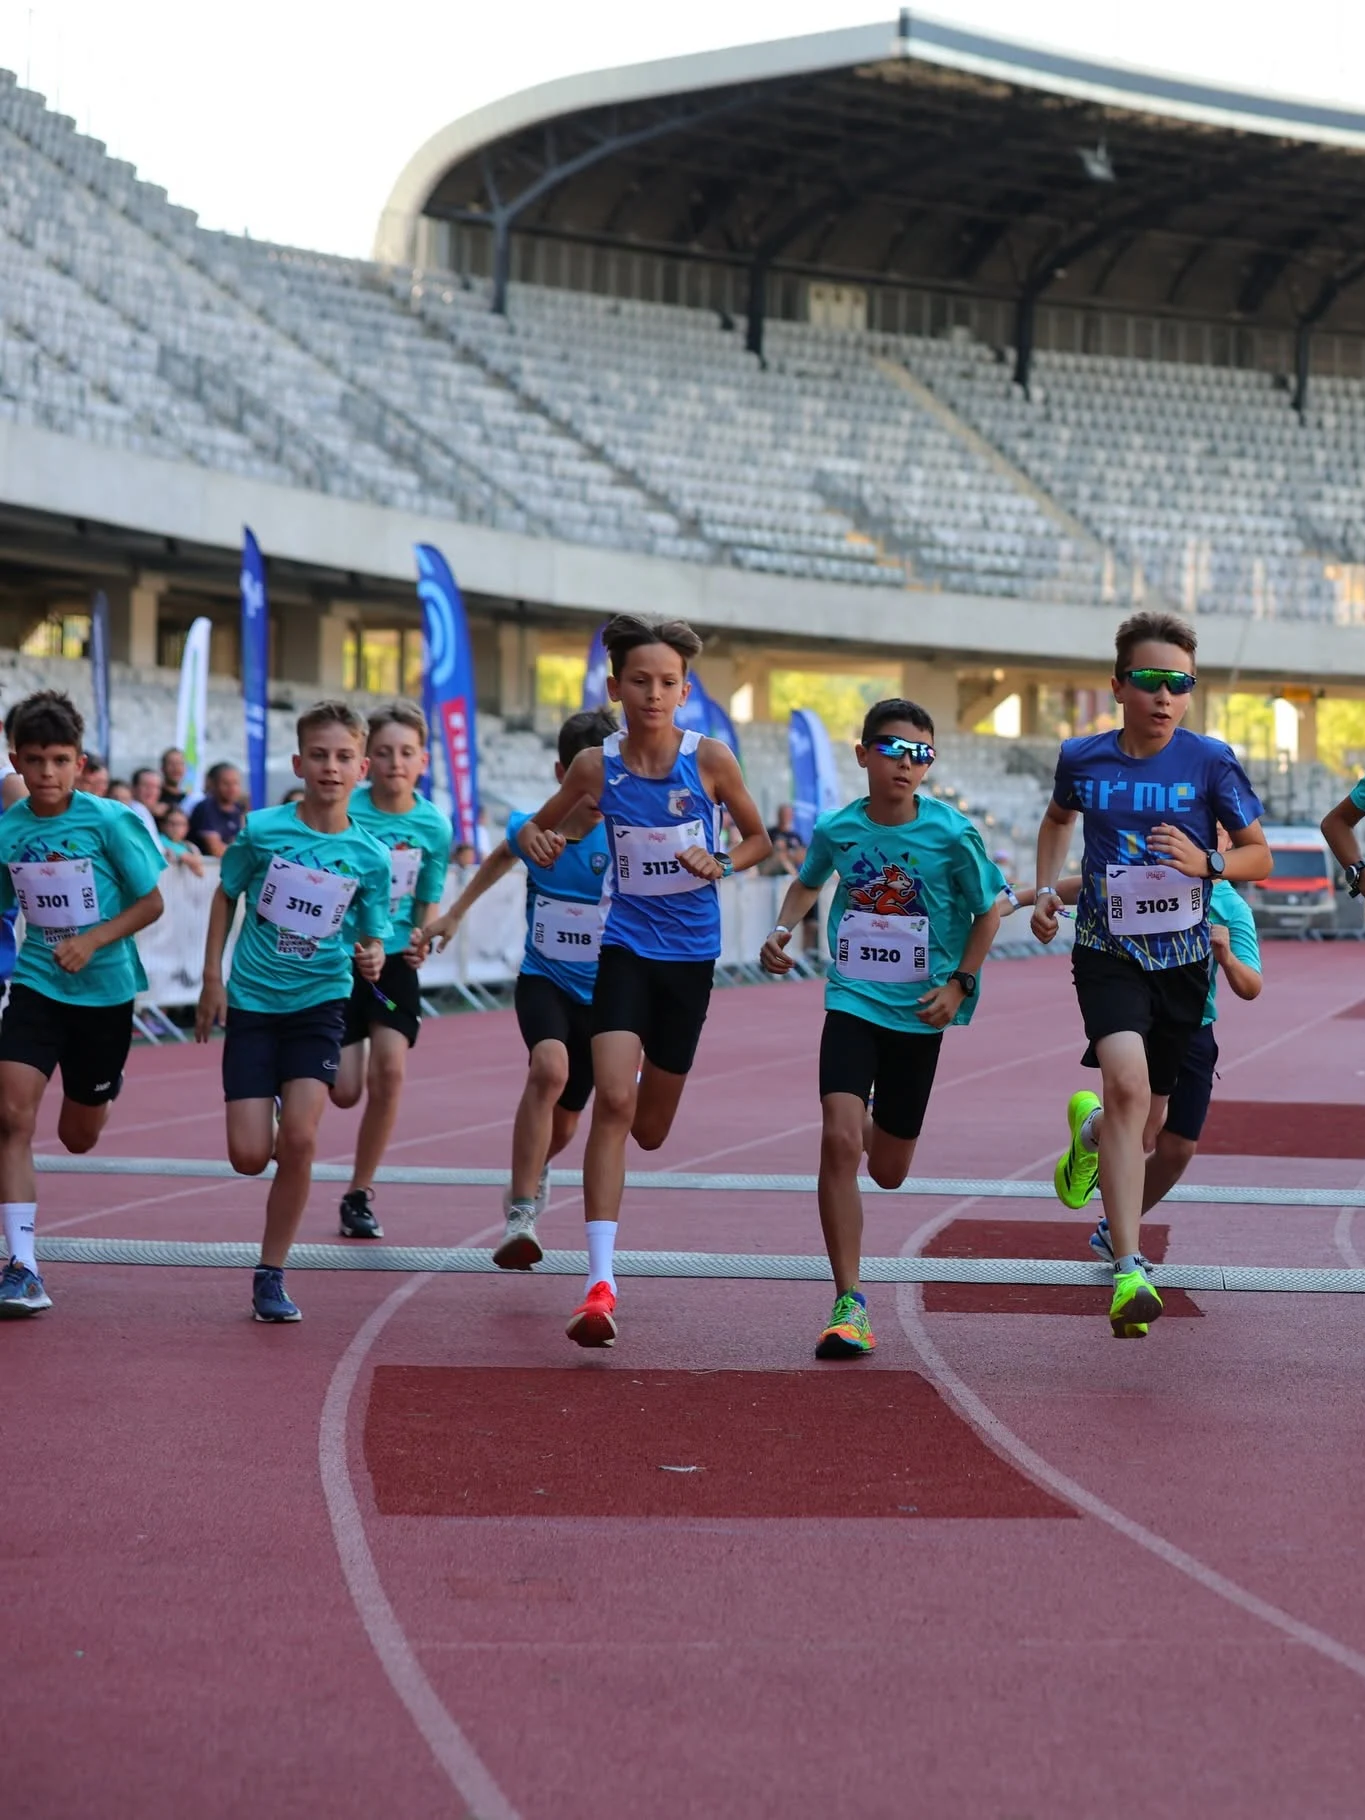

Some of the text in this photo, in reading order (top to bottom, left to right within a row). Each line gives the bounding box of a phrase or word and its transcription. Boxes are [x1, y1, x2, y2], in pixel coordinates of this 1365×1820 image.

[642, 860, 681, 876] 3113
[36, 895, 70, 908] 3101
[286, 897, 323, 917] 3116
[1135, 898, 1180, 914] 3103
[556, 931, 592, 945] 3118
[860, 947, 901, 963] 3120
